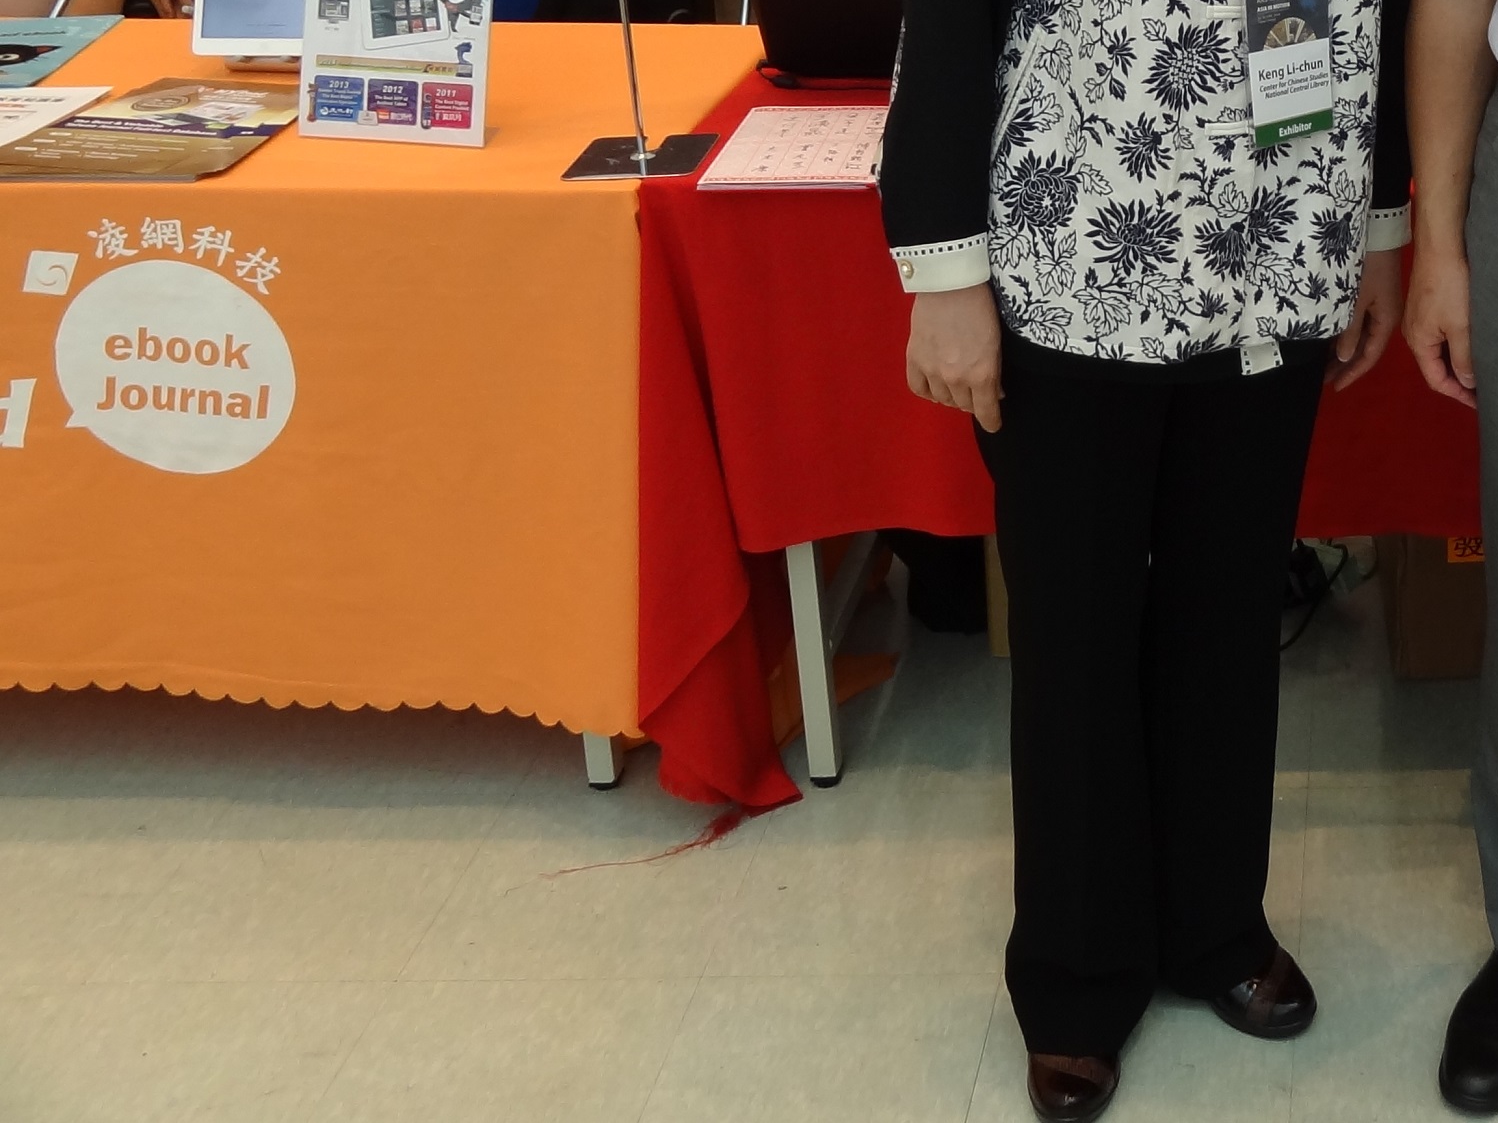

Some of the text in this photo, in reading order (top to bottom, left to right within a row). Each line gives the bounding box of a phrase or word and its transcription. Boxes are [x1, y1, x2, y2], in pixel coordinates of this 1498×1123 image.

[1258, 58, 1323, 82] Keng Li-chun
[1259, 82, 1280, 94] Center
[1287, 76, 1308, 89] Chinese
[1309, 72, 1329, 84] Studies
[1264, 79, 1330, 100] National Central Library
[1278, 122, 1312, 137] Exhibitor
[87, 217, 281, 295] 凌網科技
[104, 327, 251, 370] ebook
[97, 376, 271, 420] Journal
